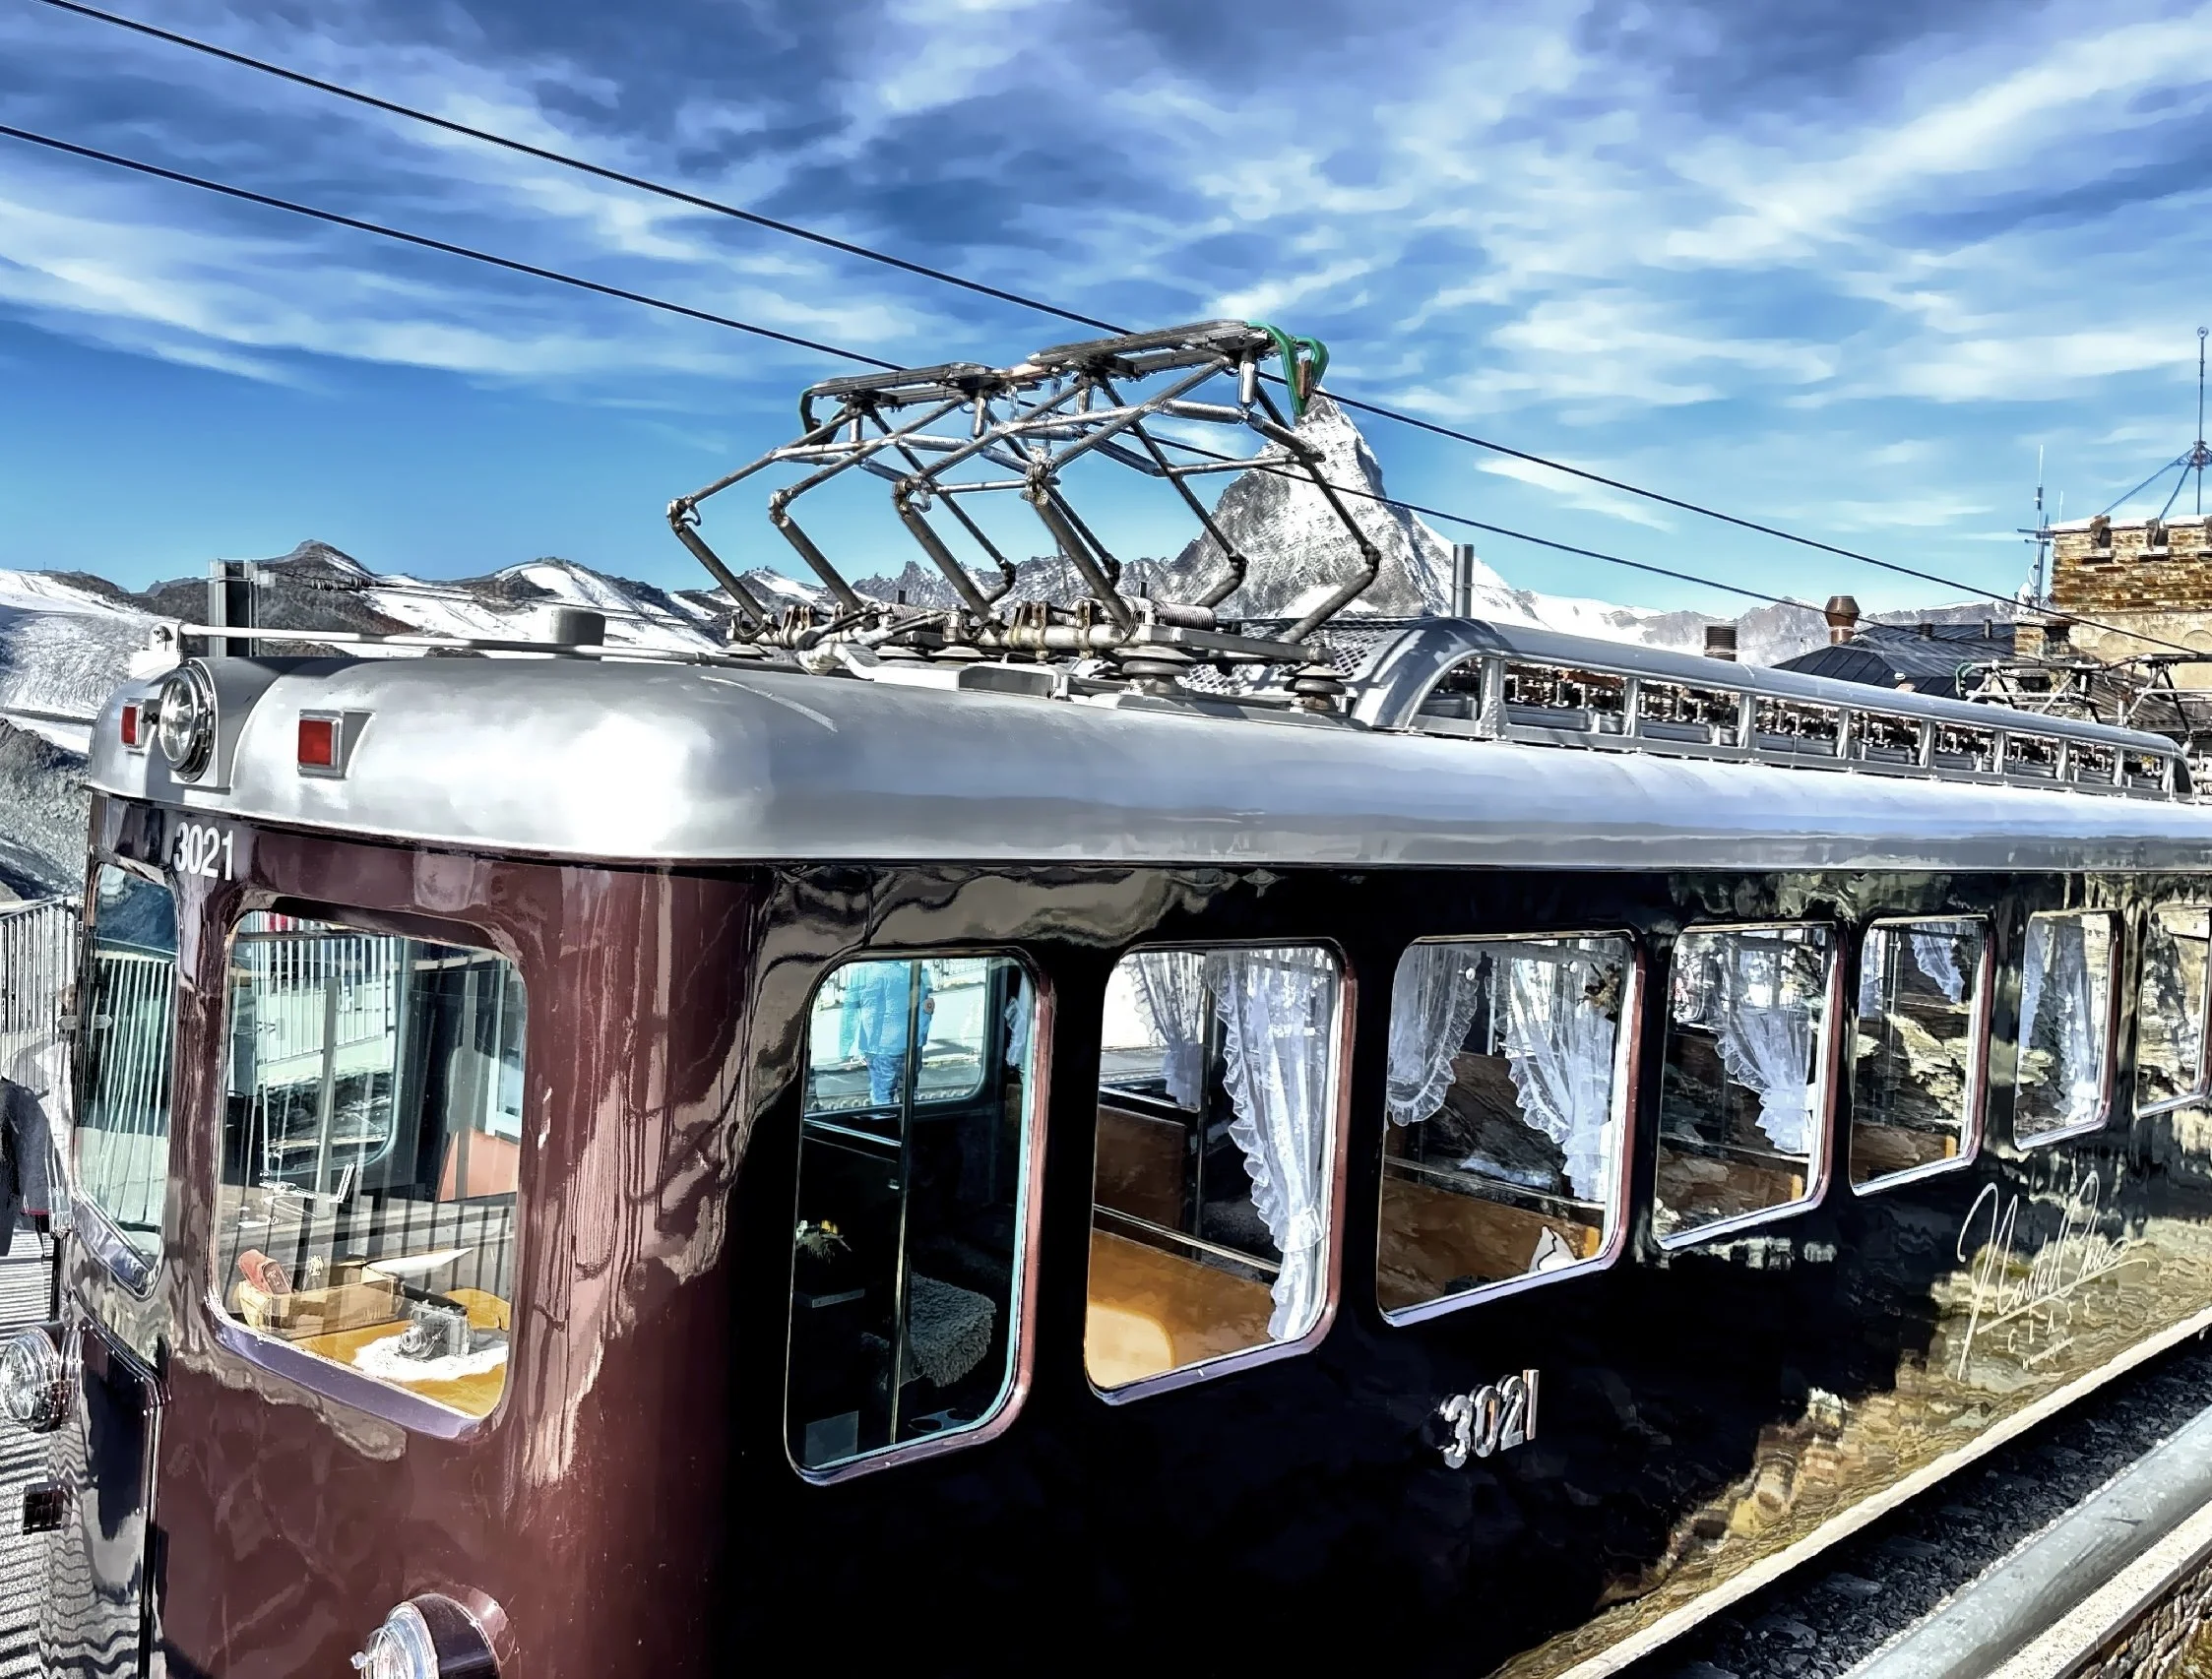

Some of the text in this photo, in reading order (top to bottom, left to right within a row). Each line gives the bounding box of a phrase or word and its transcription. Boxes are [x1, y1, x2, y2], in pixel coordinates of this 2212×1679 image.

[173, 822, 234, 881] 3021
[2008, 1292, 2092, 1354] CLASS
[1438, 1369, 1540, 1469] 3021
